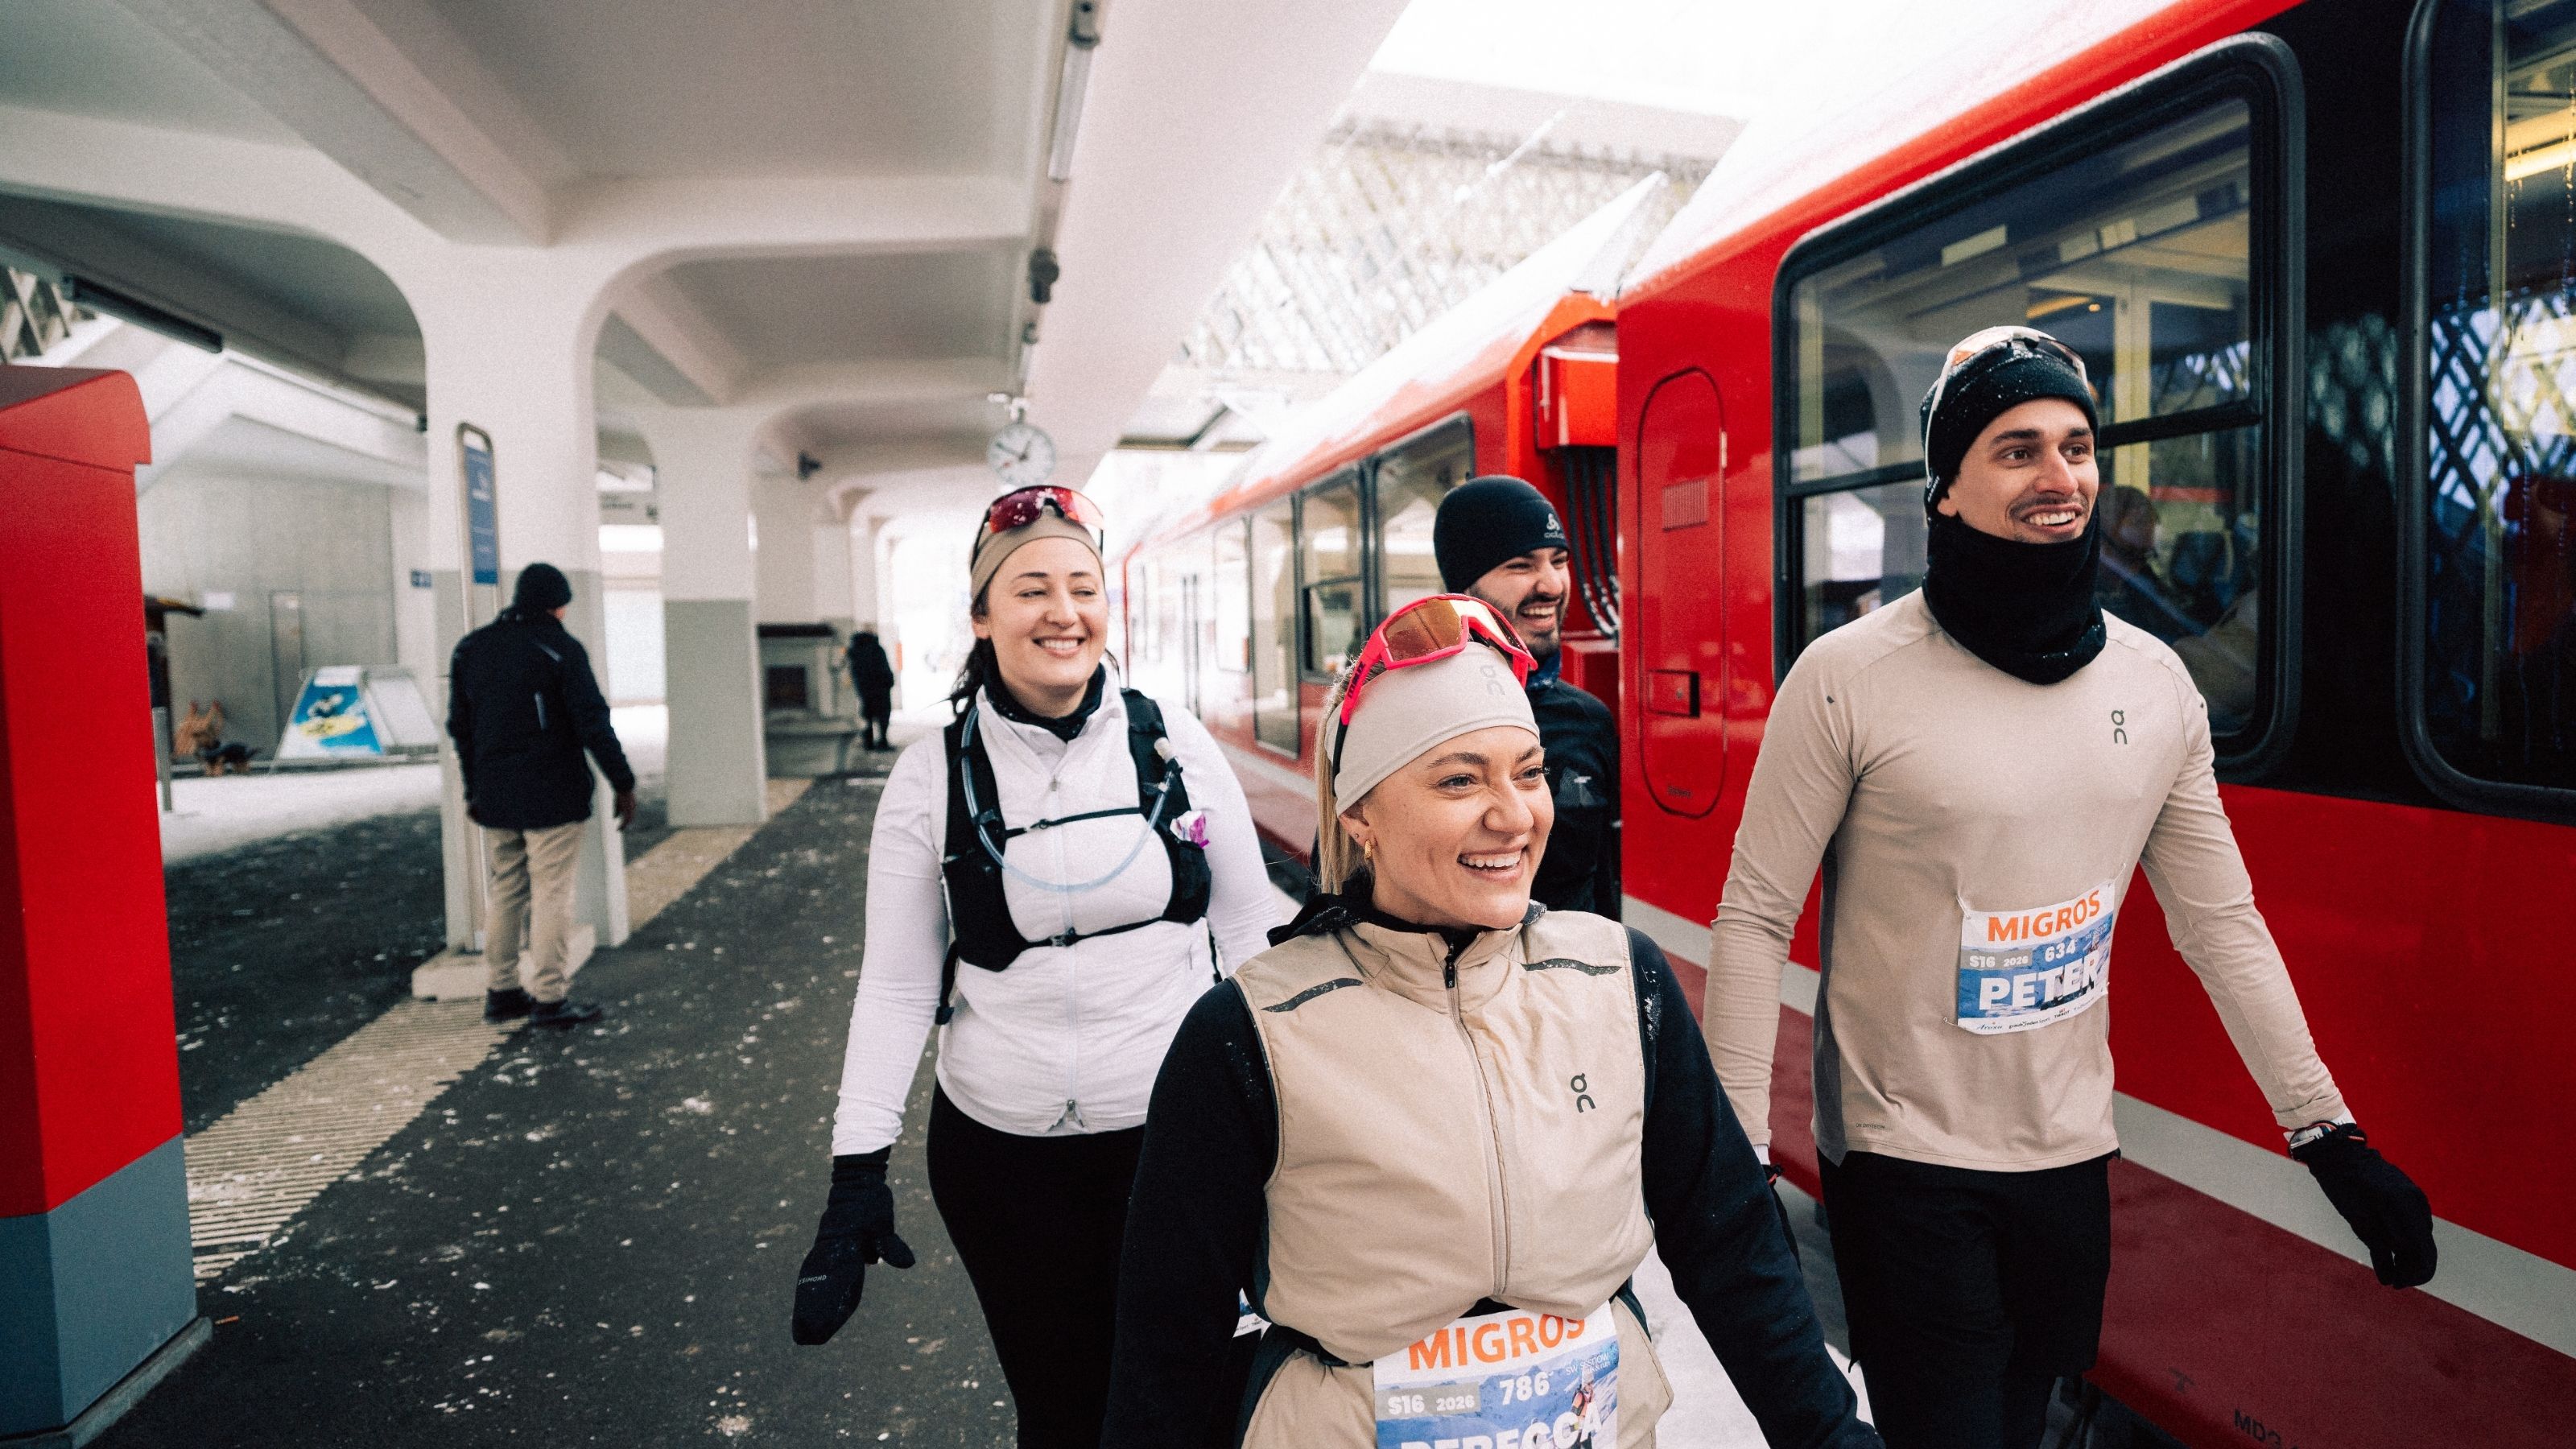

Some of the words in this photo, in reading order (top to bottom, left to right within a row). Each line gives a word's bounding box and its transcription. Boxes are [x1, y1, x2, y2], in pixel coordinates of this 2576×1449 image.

[1987, 890, 2100, 942] MIGROS
[1969, 955, 1996, 968] S16
[2003, 955, 2029, 967] 2026
[2044, 939, 2076, 963] 634
[1979, 951, 2099, 1010] PETER
[1409, 1313, 1586, 1371] MIGROS
[1387, 1394, 1425, 1415] S16
[1435, 1394, 1475, 1412] 2026
[1499, 1371, 1550, 1406] 786
